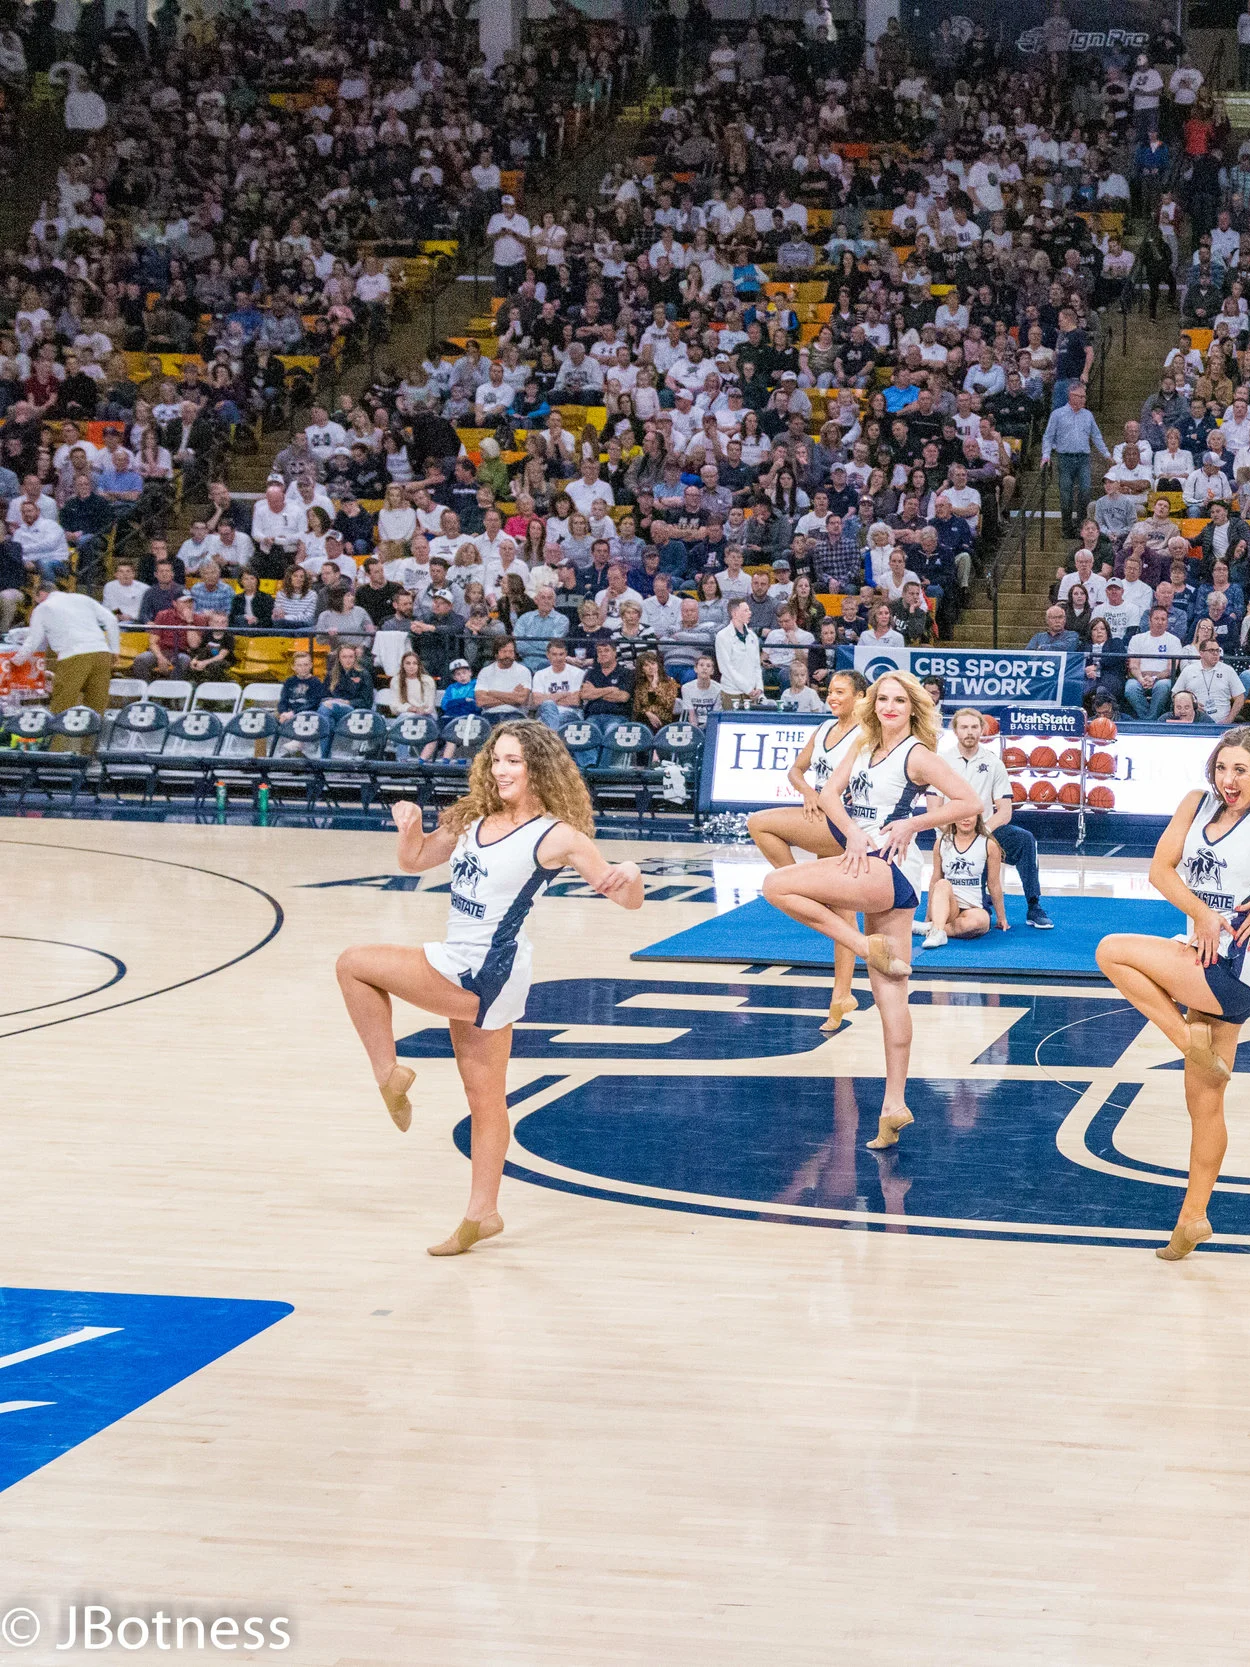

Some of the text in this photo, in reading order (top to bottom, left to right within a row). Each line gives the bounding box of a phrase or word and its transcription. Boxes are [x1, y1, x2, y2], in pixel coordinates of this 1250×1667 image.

[1068, 29, 1106, 52] ign
[914, 657, 1056, 678] CBS SPORTS
[948, 677, 1031, 696] TWORK
[1010, 712, 1076, 725] UtahState
[1010, 723, 1076, 732] BASKETBALL
[776, 731, 805, 742] THE
[853, 805, 877, 819] STATE
[456, 895, 485, 918] STATE
[1202, 892, 1233, 909] STATE
